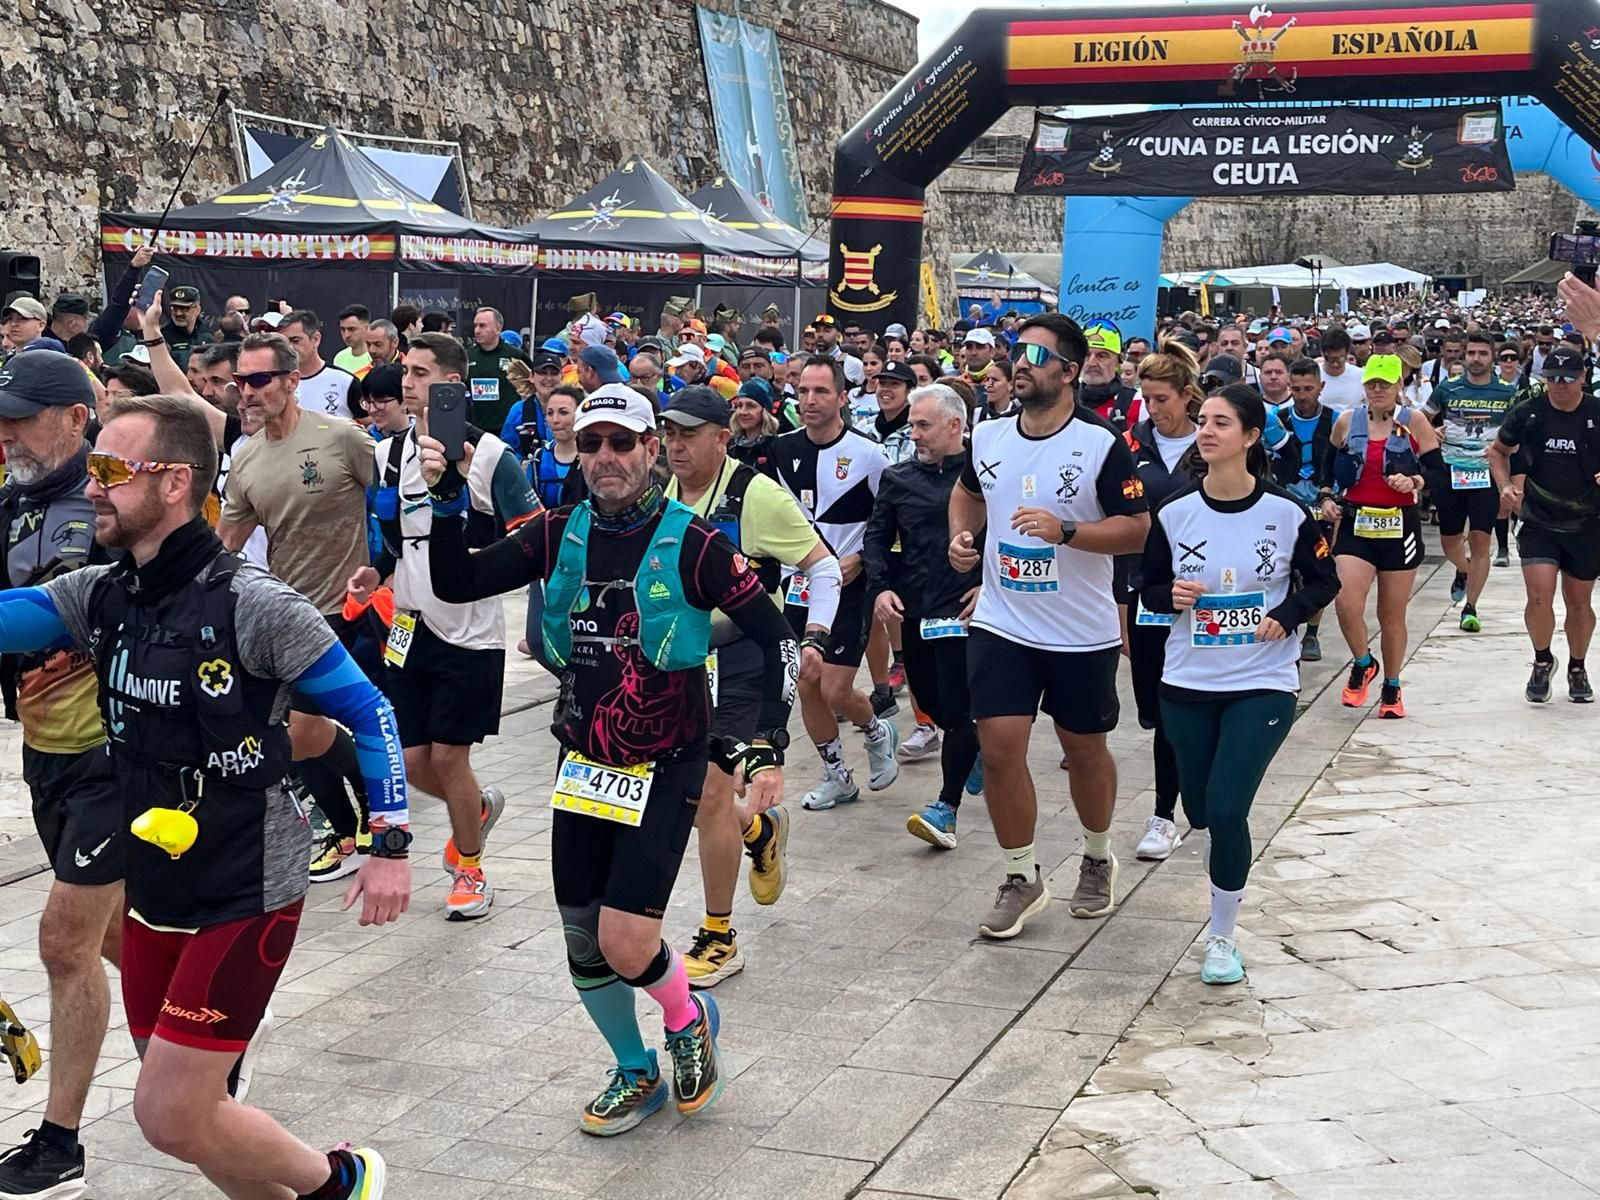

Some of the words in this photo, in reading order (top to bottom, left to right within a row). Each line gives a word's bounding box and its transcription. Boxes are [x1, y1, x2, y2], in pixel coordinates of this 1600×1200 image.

[1074, 35, 1168, 62] LEGIÓN
[1332, 26, 1478, 54] ESPAÑOLA
[903, 86, 916, 106] del
[914, 45, 964, 92] Legionario
[1193, 116, 1240, 127] CARRERA
[1243, 113, 1326, 127] CÍVICO-MILITAR
[1127, 136, 1207, 156] "CUNA
[1215, 137, 1244, 156] DE
[1252, 136, 1280, 155] LA
[1288, 128, 1394, 154] LEGIÓN"
[1212, 162, 1300, 185] CEUTA
[124, 227, 197, 254] CLUB
[204, 230, 370, 260] DEPORTIVO
[400, 234, 444, 260] TERCIO
[491, 242, 505, 265] DE
[545, 248, 681, 273] DEPORTIVO
[1068, 273, 1120, 295] Ceuta
[1124, 280, 1142, 291] es
[1458, 400, 1508, 409] FORTALEZA
[1464, 471, 1486, 480] 2772
[1373, 516, 1400, 528] 5812
[1014, 560, 1052, 576] 1287
[1217, 608, 1261, 628] 2836
[382, 778, 392, 804] Olvera
[590, 770, 644, 802] 4703
